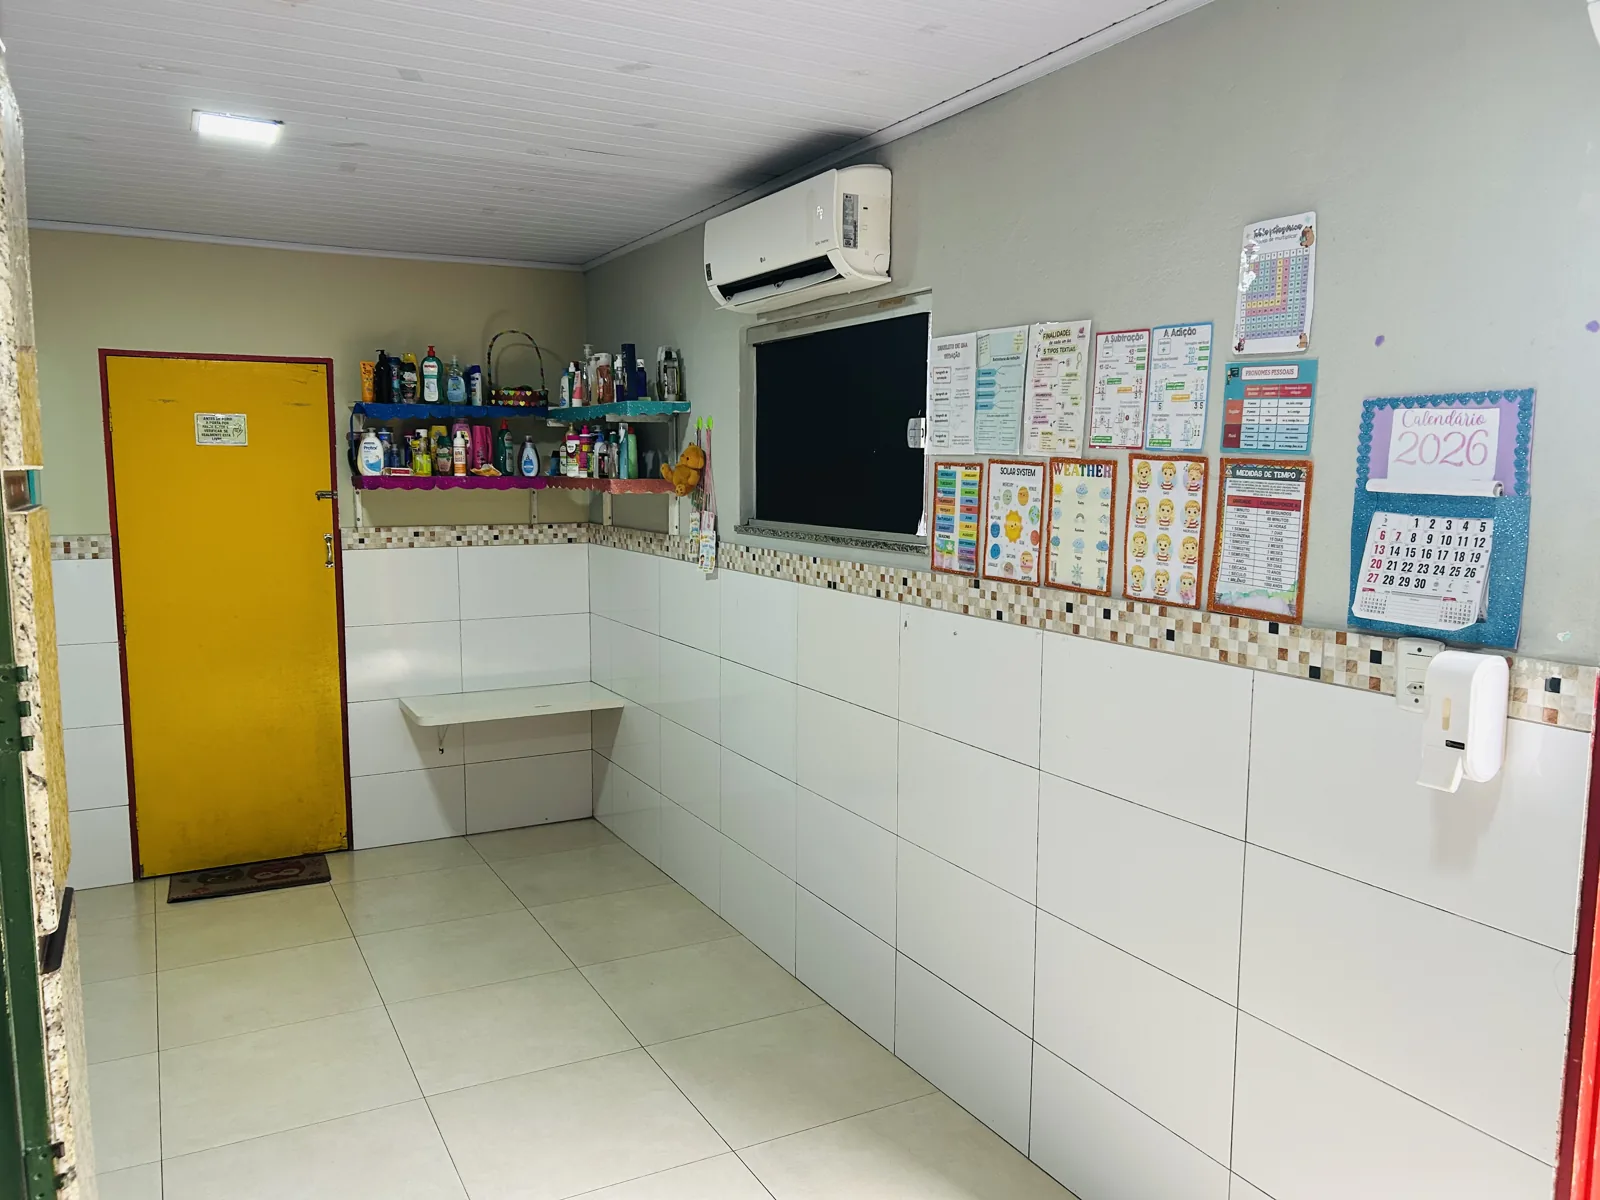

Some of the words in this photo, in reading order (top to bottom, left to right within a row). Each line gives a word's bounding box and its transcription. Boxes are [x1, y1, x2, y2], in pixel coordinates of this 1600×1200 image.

[1043, 329, 1070, 340] FINALIDADES
[1111, 333, 1143, 342] Subtração
[1171, 327, 1196, 338] Adição
[1402, 410, 1487, 428] Calendário
[1392, 429, 1488, 467] 2026
[1000, 467, 1015, 475] SOLAR
[1016, 468, 1036, 476] SYSTEM
[1054, 463, 1111, 478] WEATHER
[1414, 518, 1419, 528] 1
[1429, 519, 1436, 529] 2
[1446, 520, 1452, 530] 3
[1463, 521, 1469, 531] 4
[1480, 522, 1486, 532] 5
[1380, 530, 1386, 540] 6
[1396, 532, 1402, 541] 7
[1410, 533, 1416, 542] 8
[1426, 534, 1433, 544] 9
[1441, 535, 1452, 546] 10
[1458, 536, 1468, 547] 11
[1474, 537, 1486, 548] 12
[1374, 544, 1385, 555] 13
[1390, 546, 1400, 556] 14
[1405, 547, 1416, 557] 15
[1421, 548, 1432, 559] 16
[1437, 550, 1449, 560] 17
[1454, 551, 1465, 562] 18
[1470, 553, 1481, 563] 19
[1370, 559, 1382, 569] 20
[1386, 560, 1397, 571] 21
[1401, 562, 1413, 573] 22
[1417, 564, 1429, 574] 23
[1433, 565, 1445, 576] 24
[1449, 566, 1461, 577] 25
[1464, 568, 1476, 578] 26
[1367, 573, 1379, 583] 27
[1382, 575, 1395, 586] 28
[1398, 577, 1410, 587] 29
[1414, 579, 1426, 589] 30
